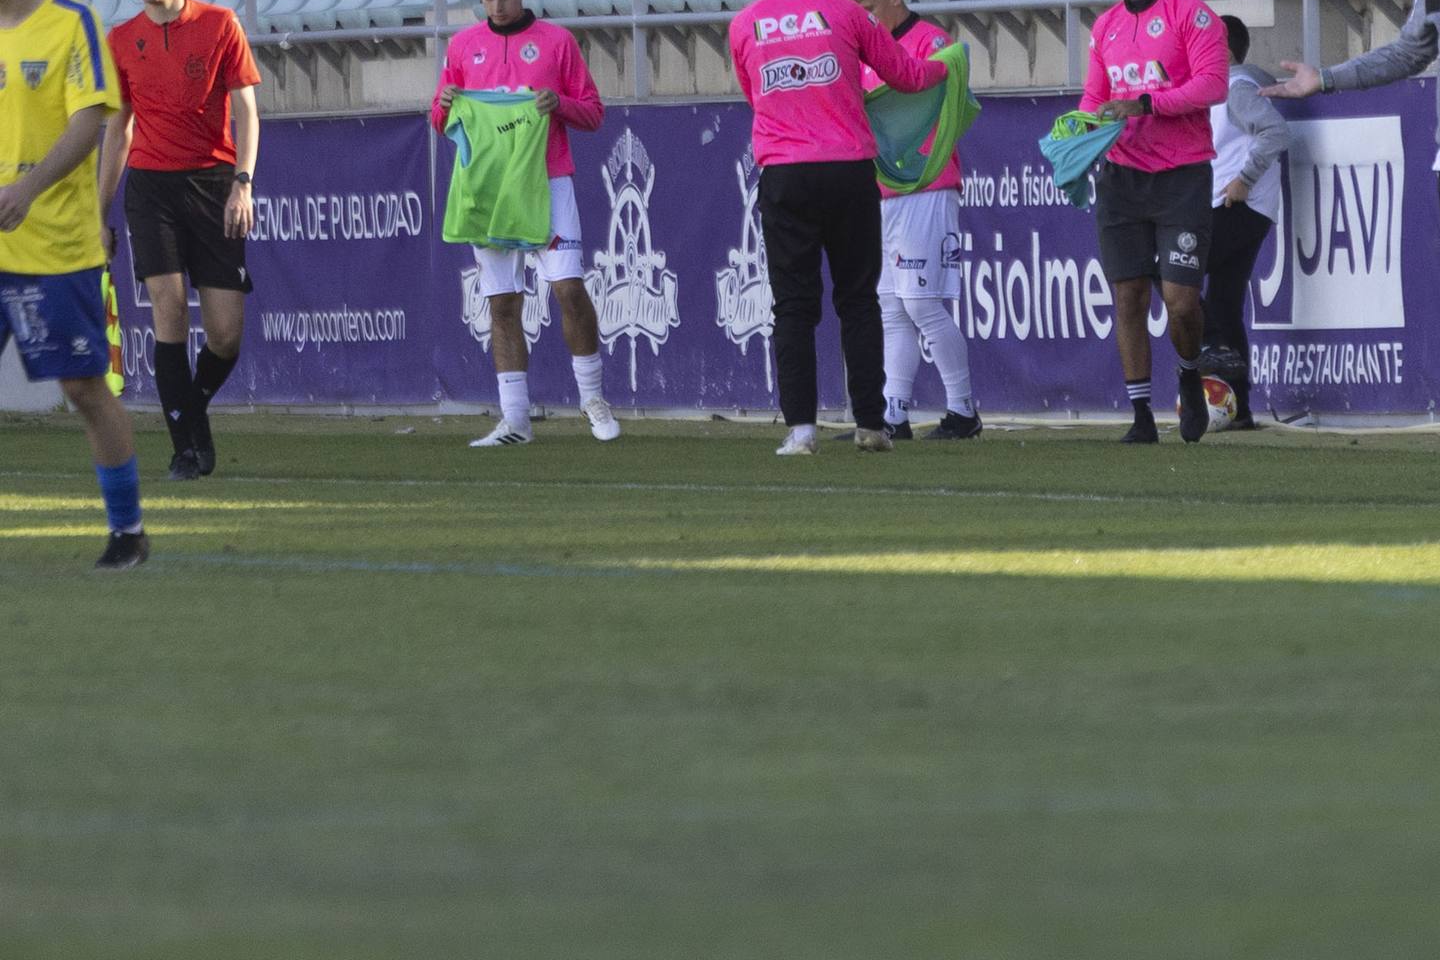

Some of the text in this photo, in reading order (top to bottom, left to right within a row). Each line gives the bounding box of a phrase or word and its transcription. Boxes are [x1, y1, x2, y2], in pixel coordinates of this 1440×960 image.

[1000, 167, 1019, 208] de
[246, 193, 423, 242] GENCIA DE PUBLICIDAD
[1297, 161, 1394, 276] JAVI
[261, 304, 406, 352] www.grupoantena.com
[1251, 343, 1404, 384] BAR RESTAURANTE
